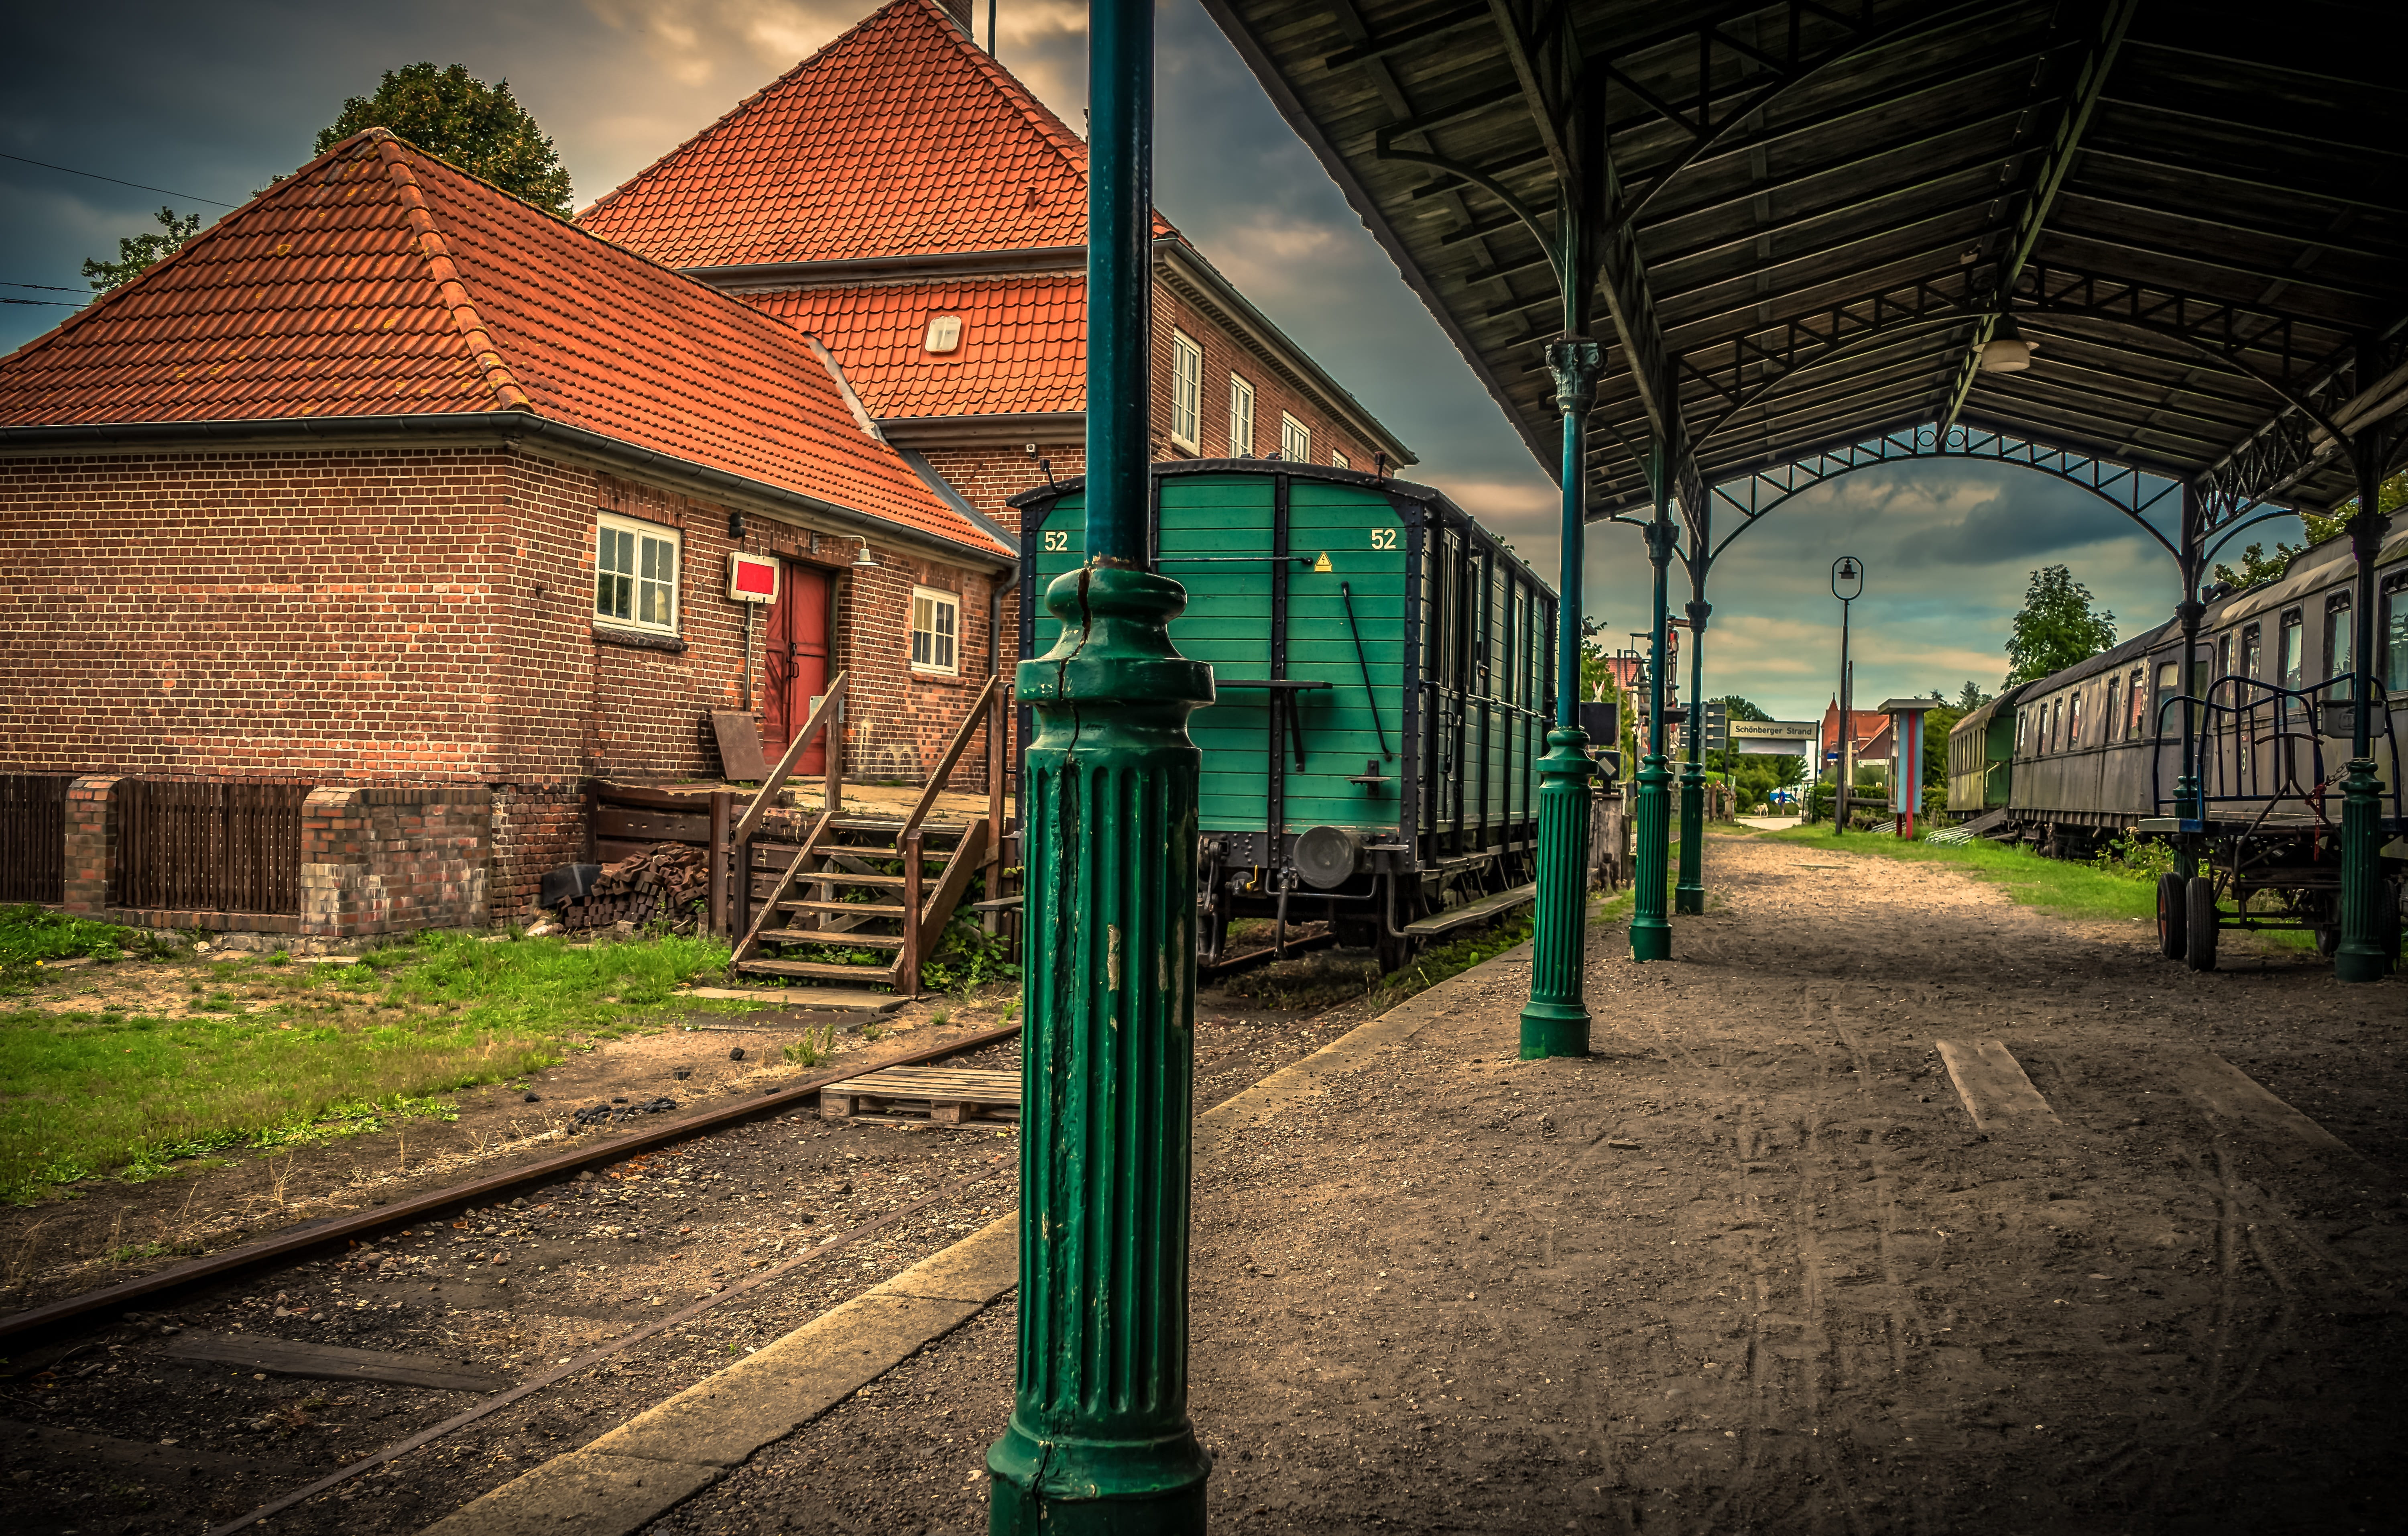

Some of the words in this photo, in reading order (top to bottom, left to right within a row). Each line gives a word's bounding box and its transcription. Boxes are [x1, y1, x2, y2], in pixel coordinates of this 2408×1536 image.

[1045, 532, 1068, 551] 52
[1372, 529, 1396, 550] 52
[1735, 725, 1782, 735] Schönberger
[1787, 727, 1812, 735] Strand
